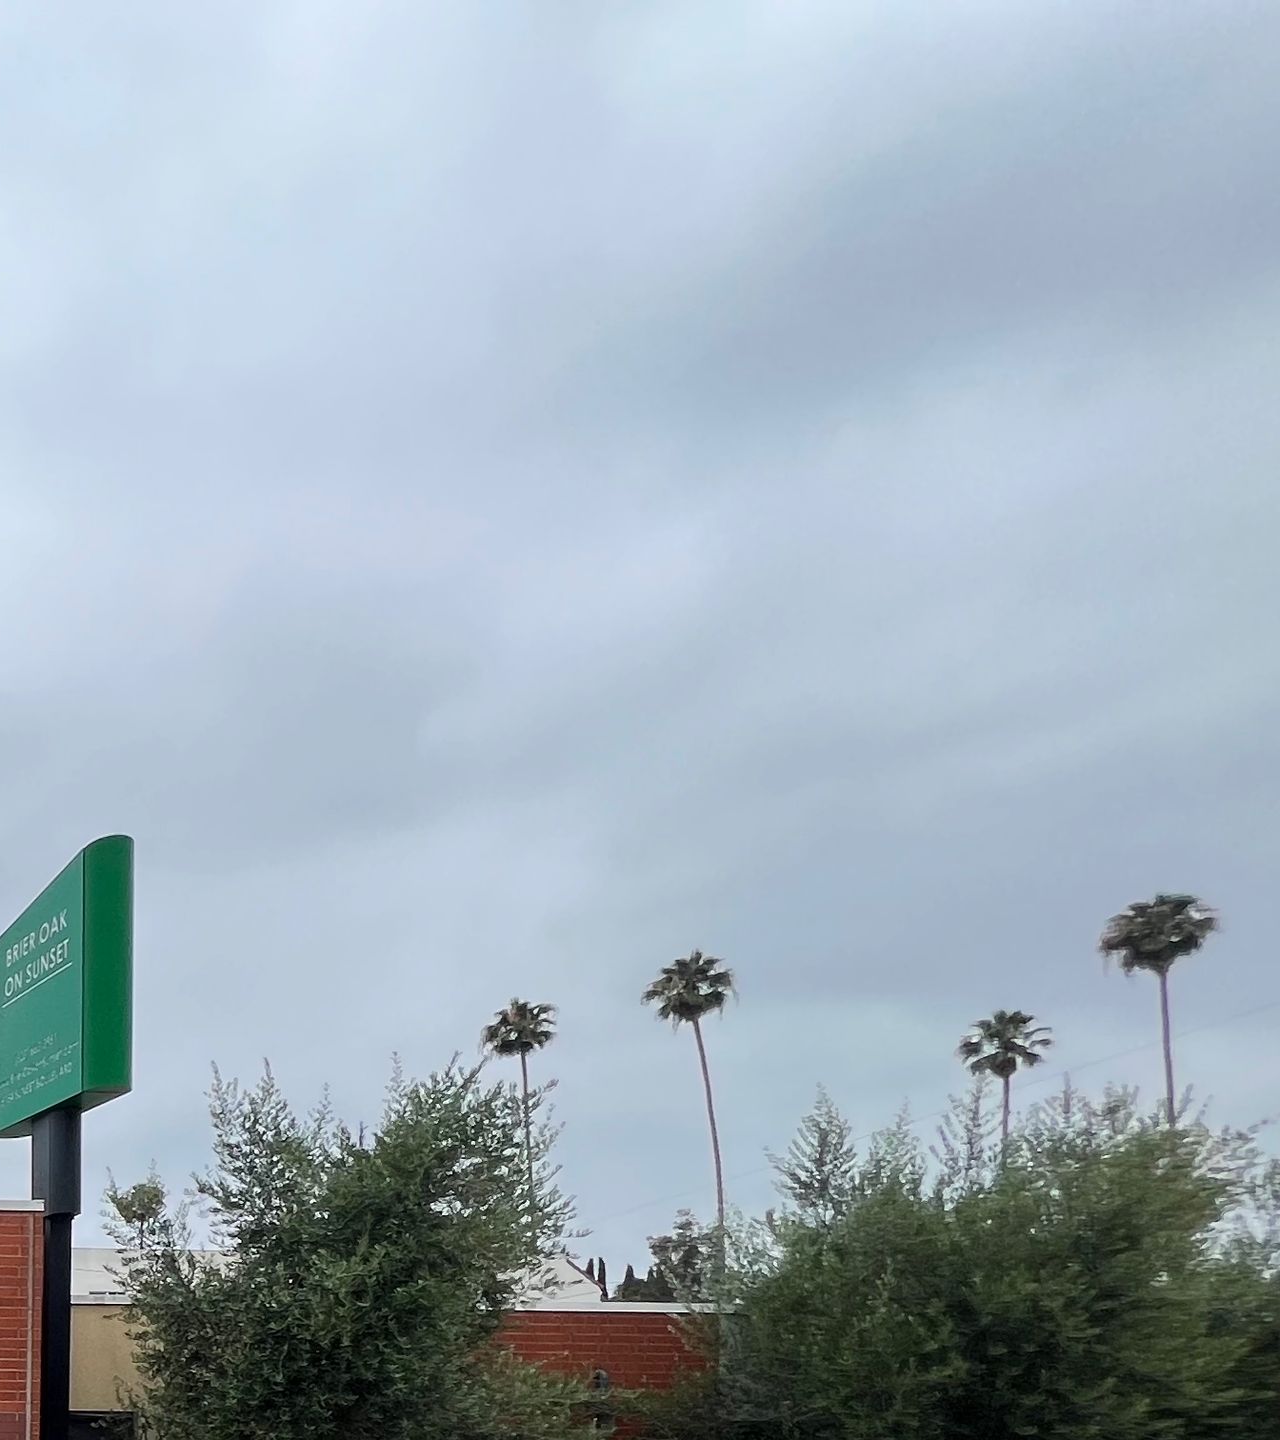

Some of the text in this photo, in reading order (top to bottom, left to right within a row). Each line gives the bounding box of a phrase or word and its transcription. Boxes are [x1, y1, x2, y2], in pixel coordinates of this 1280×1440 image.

[4, 938, 70, 997] ON SUNSET
[6, 908, 68, 968] BRIER OAK
